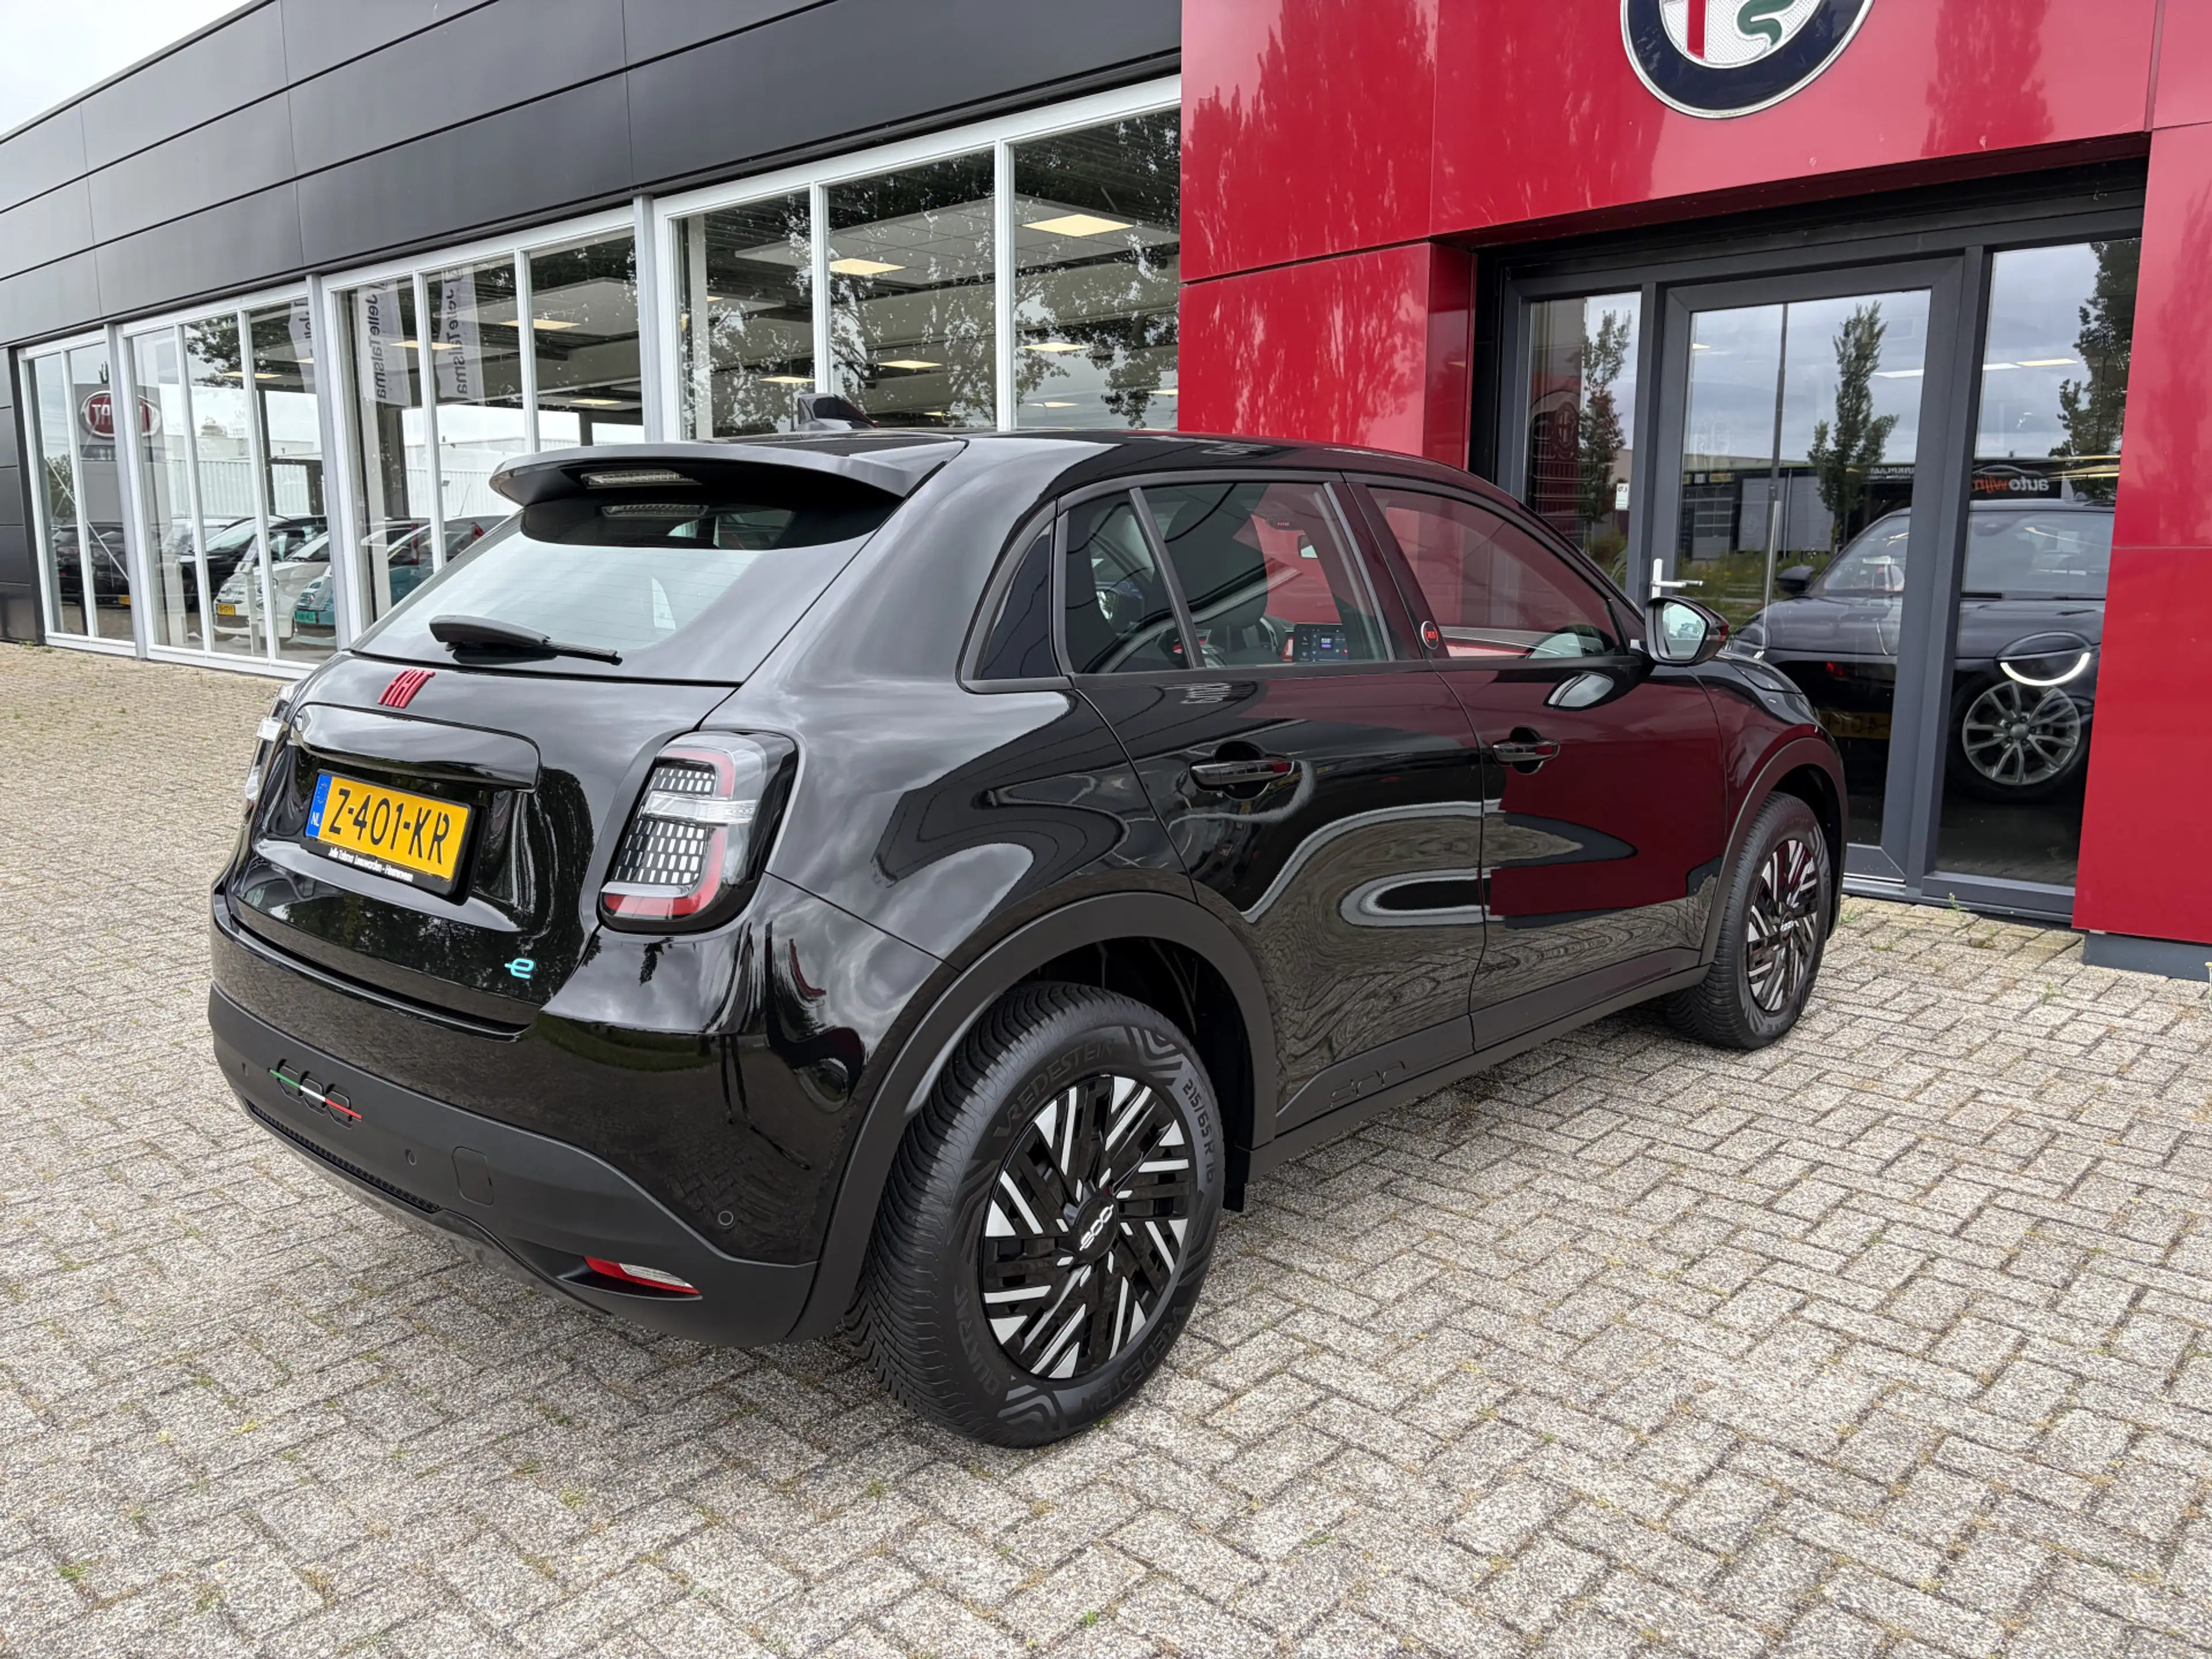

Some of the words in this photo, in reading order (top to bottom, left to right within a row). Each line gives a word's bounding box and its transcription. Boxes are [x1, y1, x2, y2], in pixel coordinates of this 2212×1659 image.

[377, 669, 435, 709] FIAT
[310, 812, 320, 827] NL
[328, 787, 450, 865] Z-401-KR
[993, 1039, 1115, 1138] VREDESTEIN
